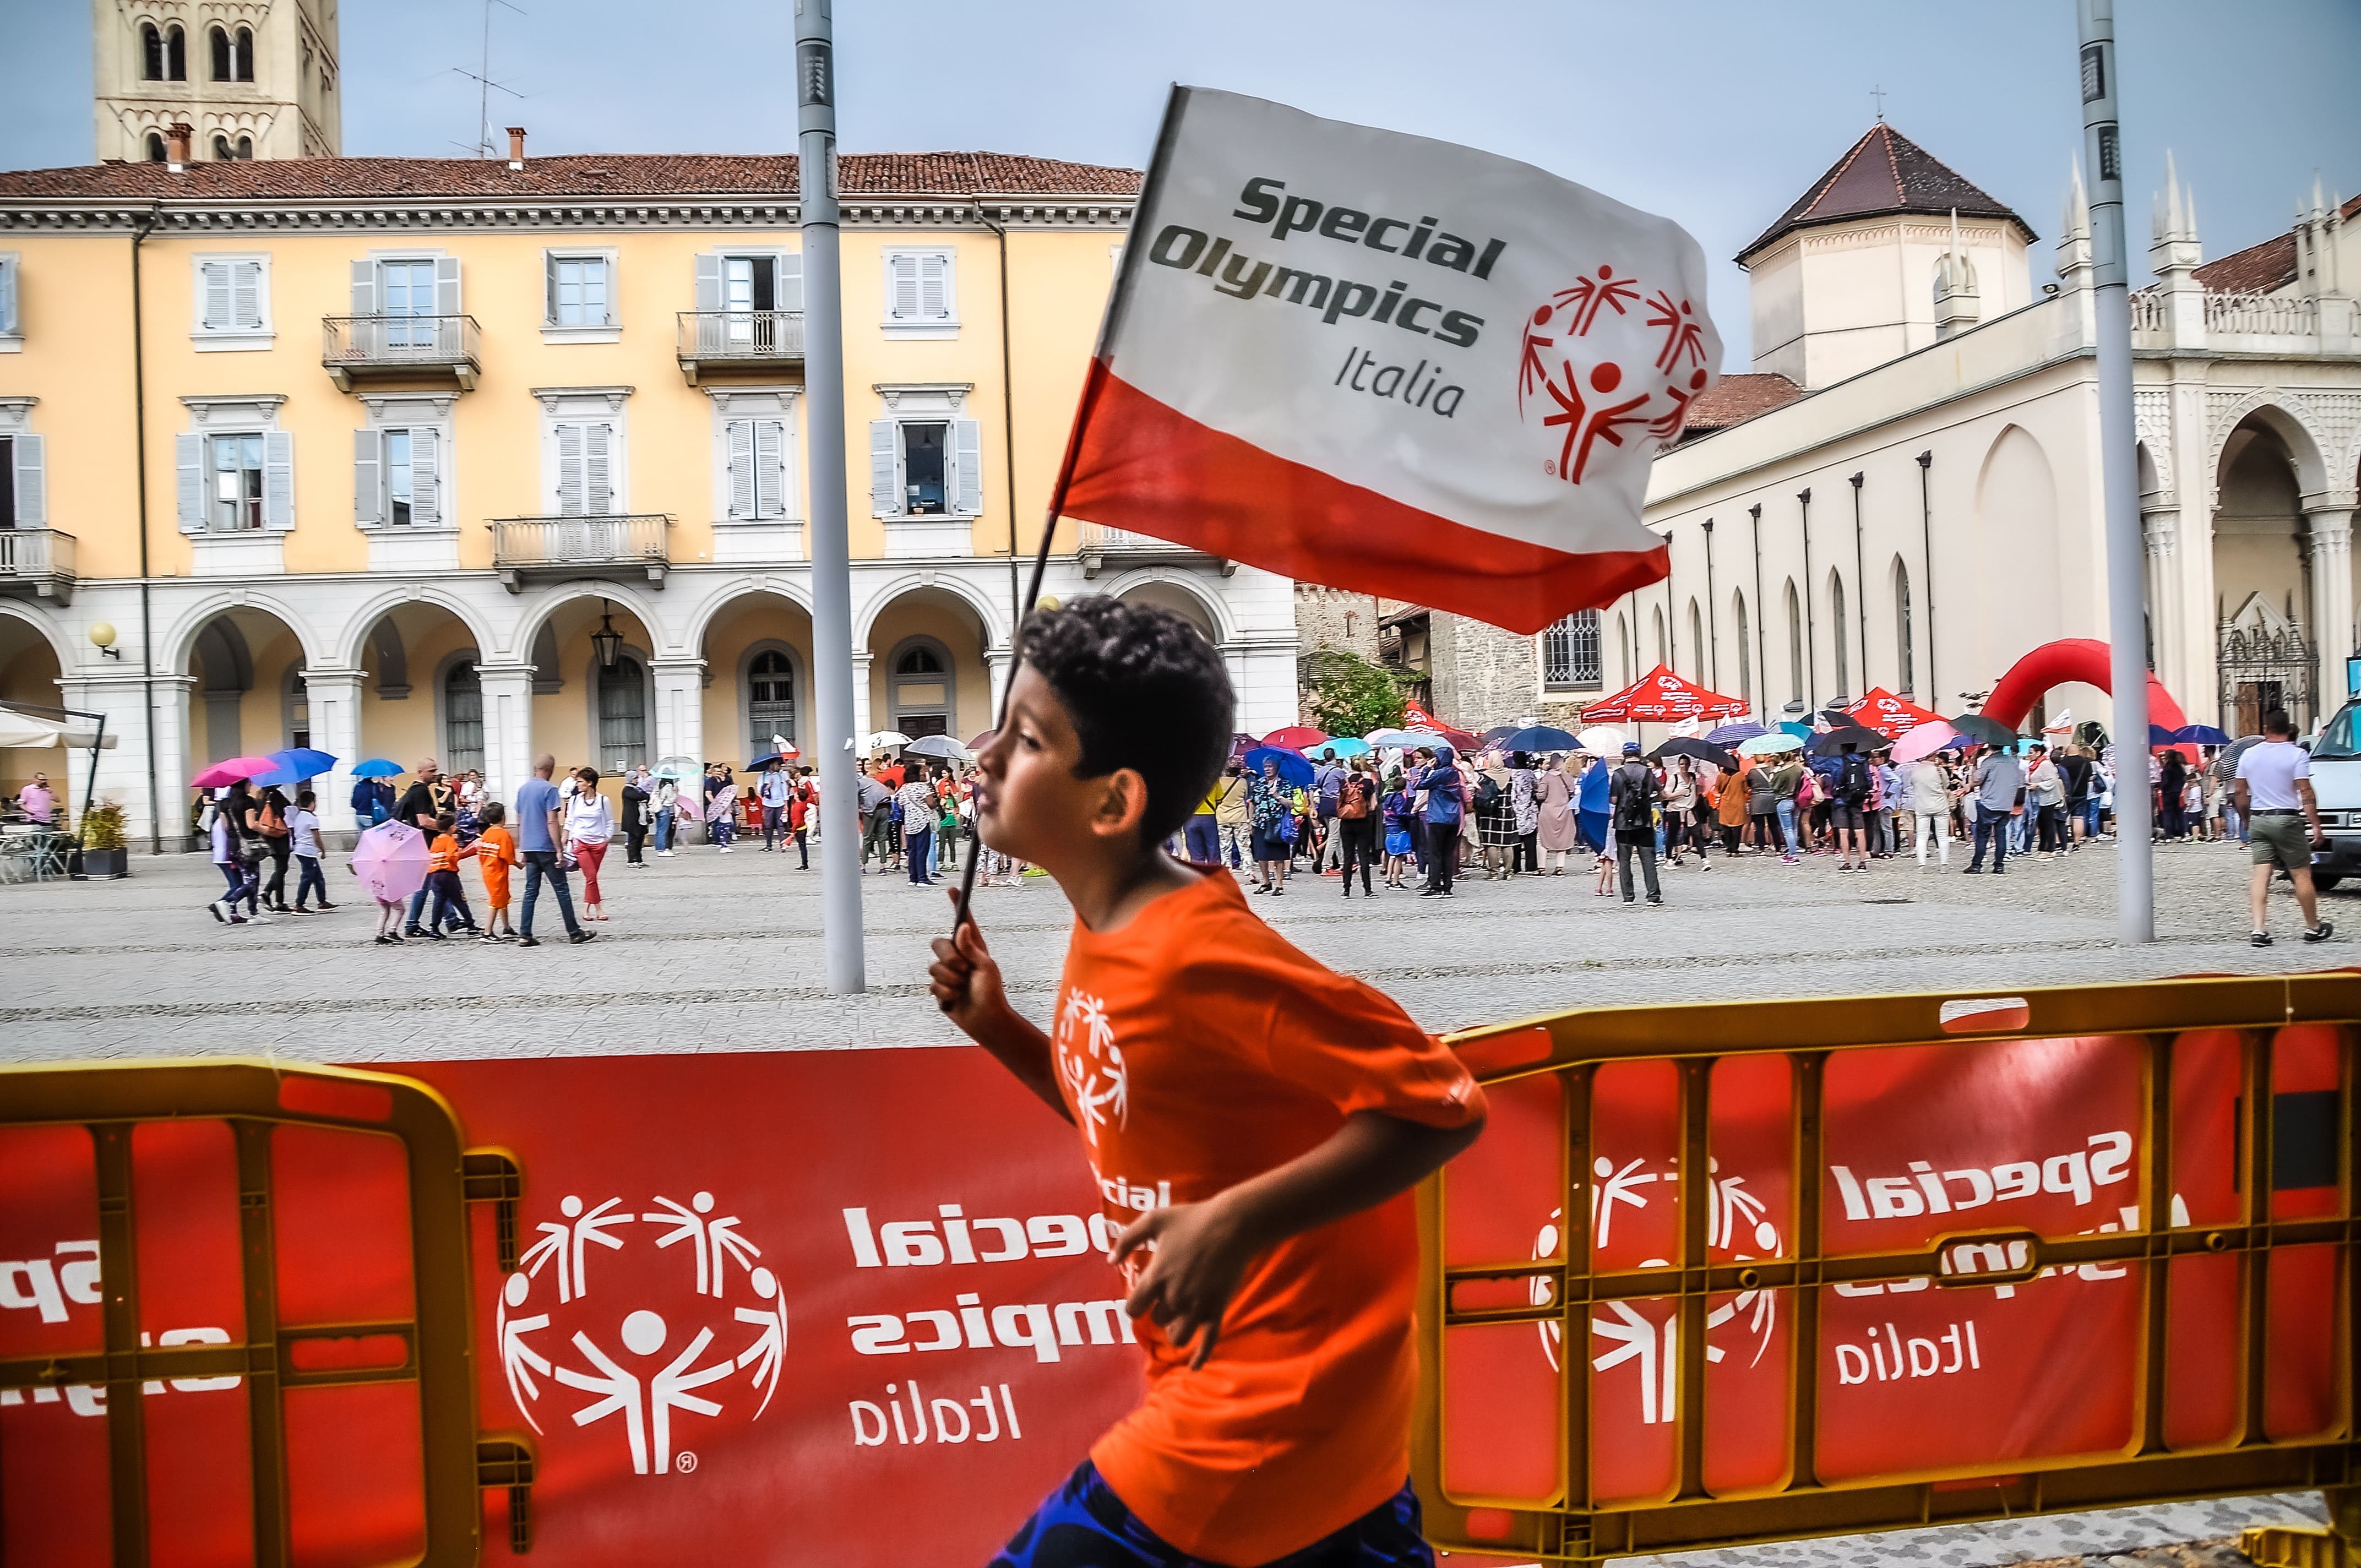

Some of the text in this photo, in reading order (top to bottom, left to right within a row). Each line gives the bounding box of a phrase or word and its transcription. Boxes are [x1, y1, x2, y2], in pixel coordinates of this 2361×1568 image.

[1233, 176, 1506, 281] Special
[1149, 224, 1485, 348] Olympics
[1335, 346, 1465, 418] Italia
